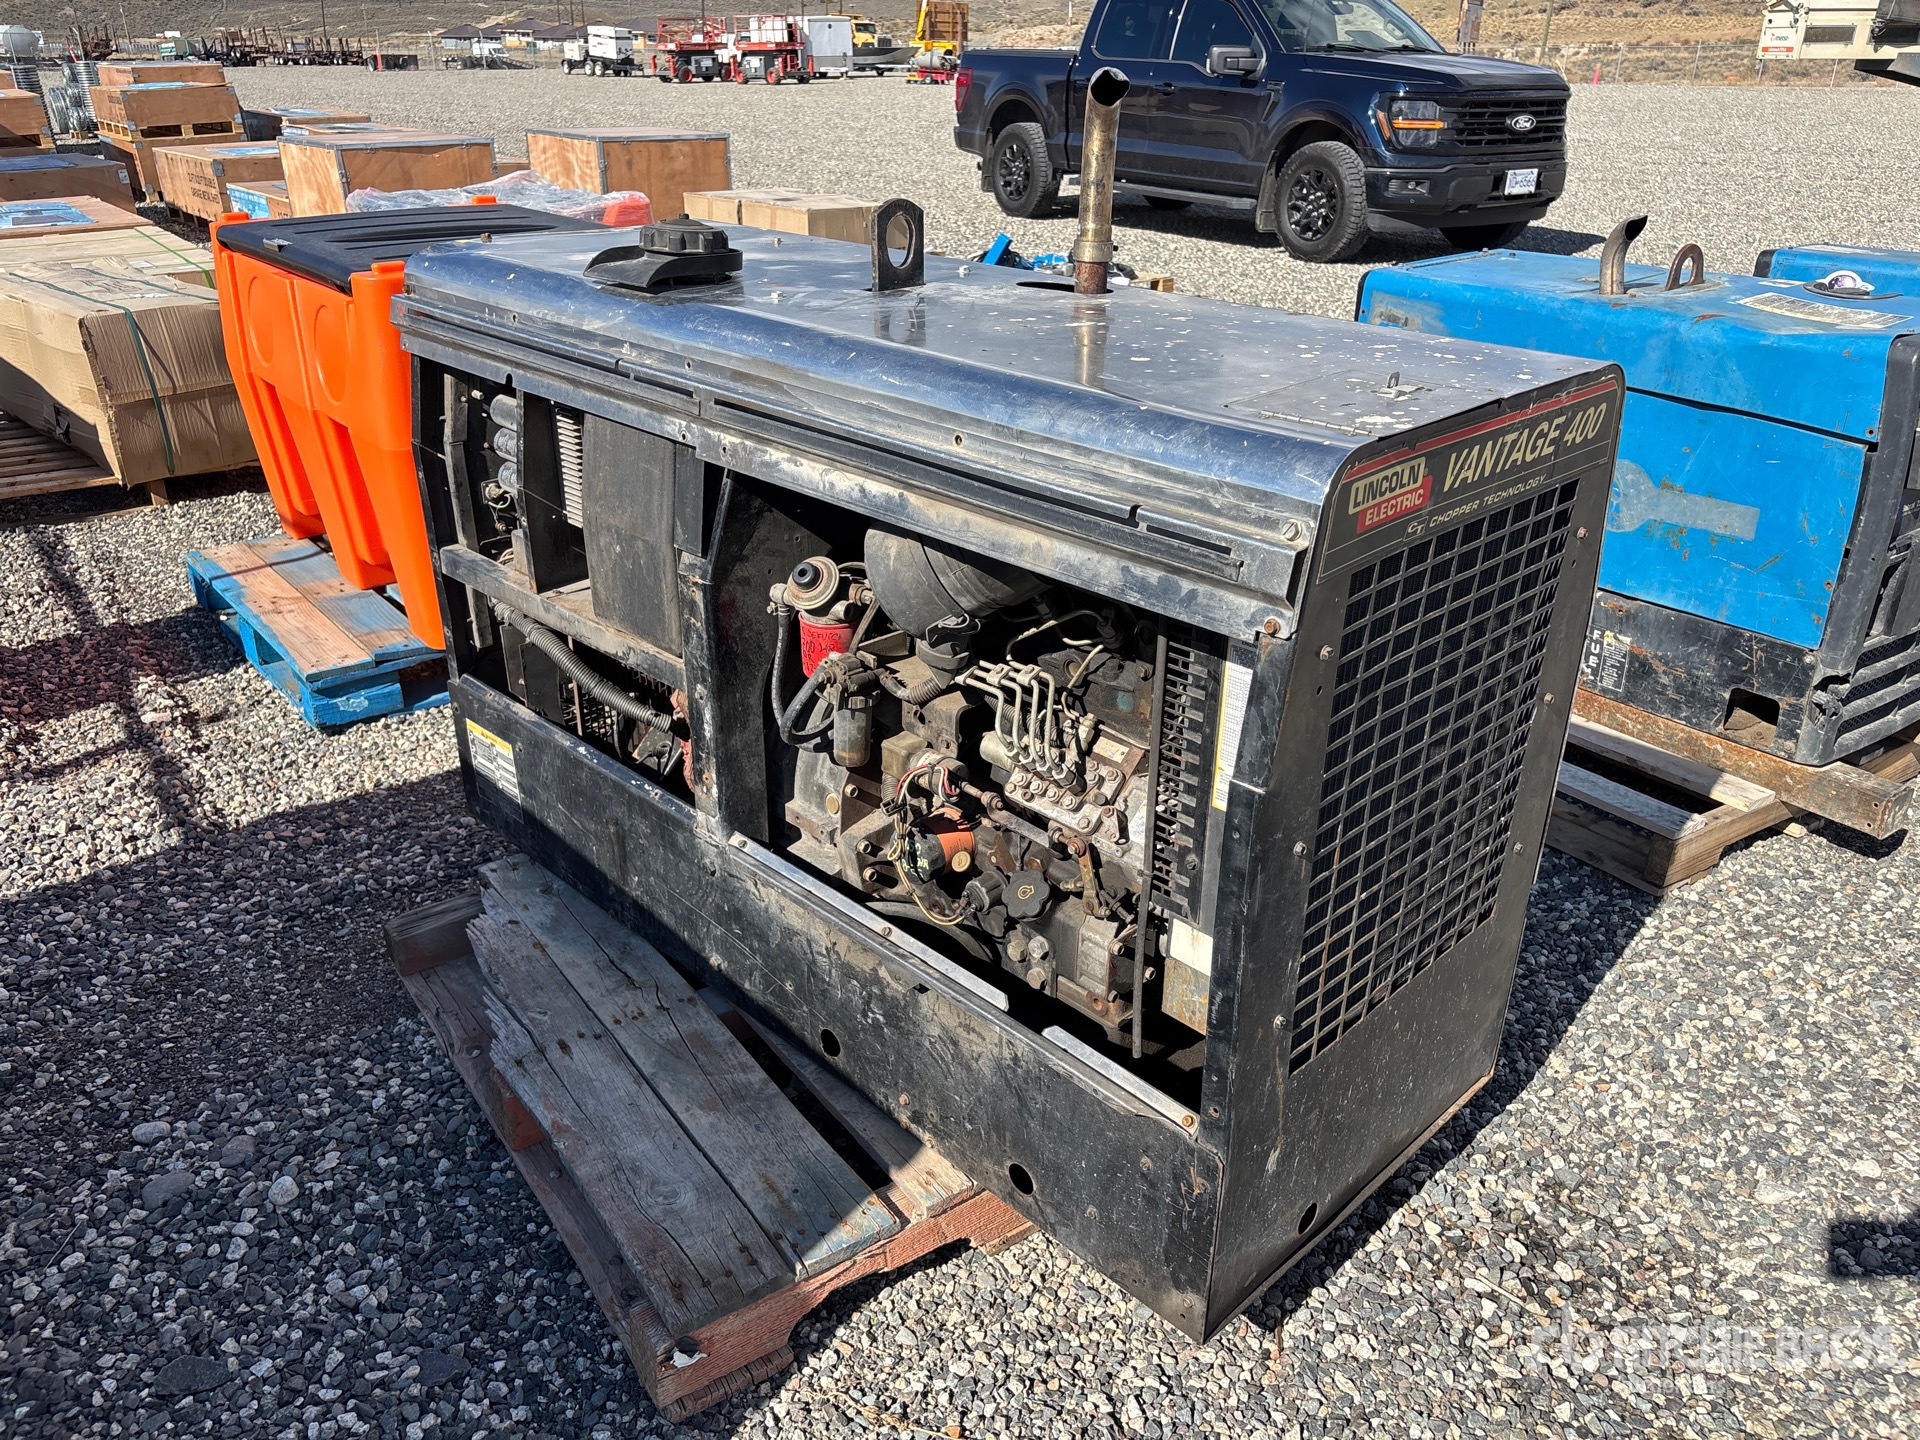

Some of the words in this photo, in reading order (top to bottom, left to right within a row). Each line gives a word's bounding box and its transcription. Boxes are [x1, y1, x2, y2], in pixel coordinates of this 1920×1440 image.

[1516, 117, 1532, 128] Ford
[1443, 415, 1567, 492] VANTAGE
[1563, 403, 1607, 447] 400
[1353, 468, 1421, 508] LINCOLN
[1365, 488, 1424, 526] ELECTRIC
[1408, 522, 1425, 535] CT
[1429, 500, 1480, 527] CHOPPER
[1483, 474, 1546, 507] TECHNOLOGY
